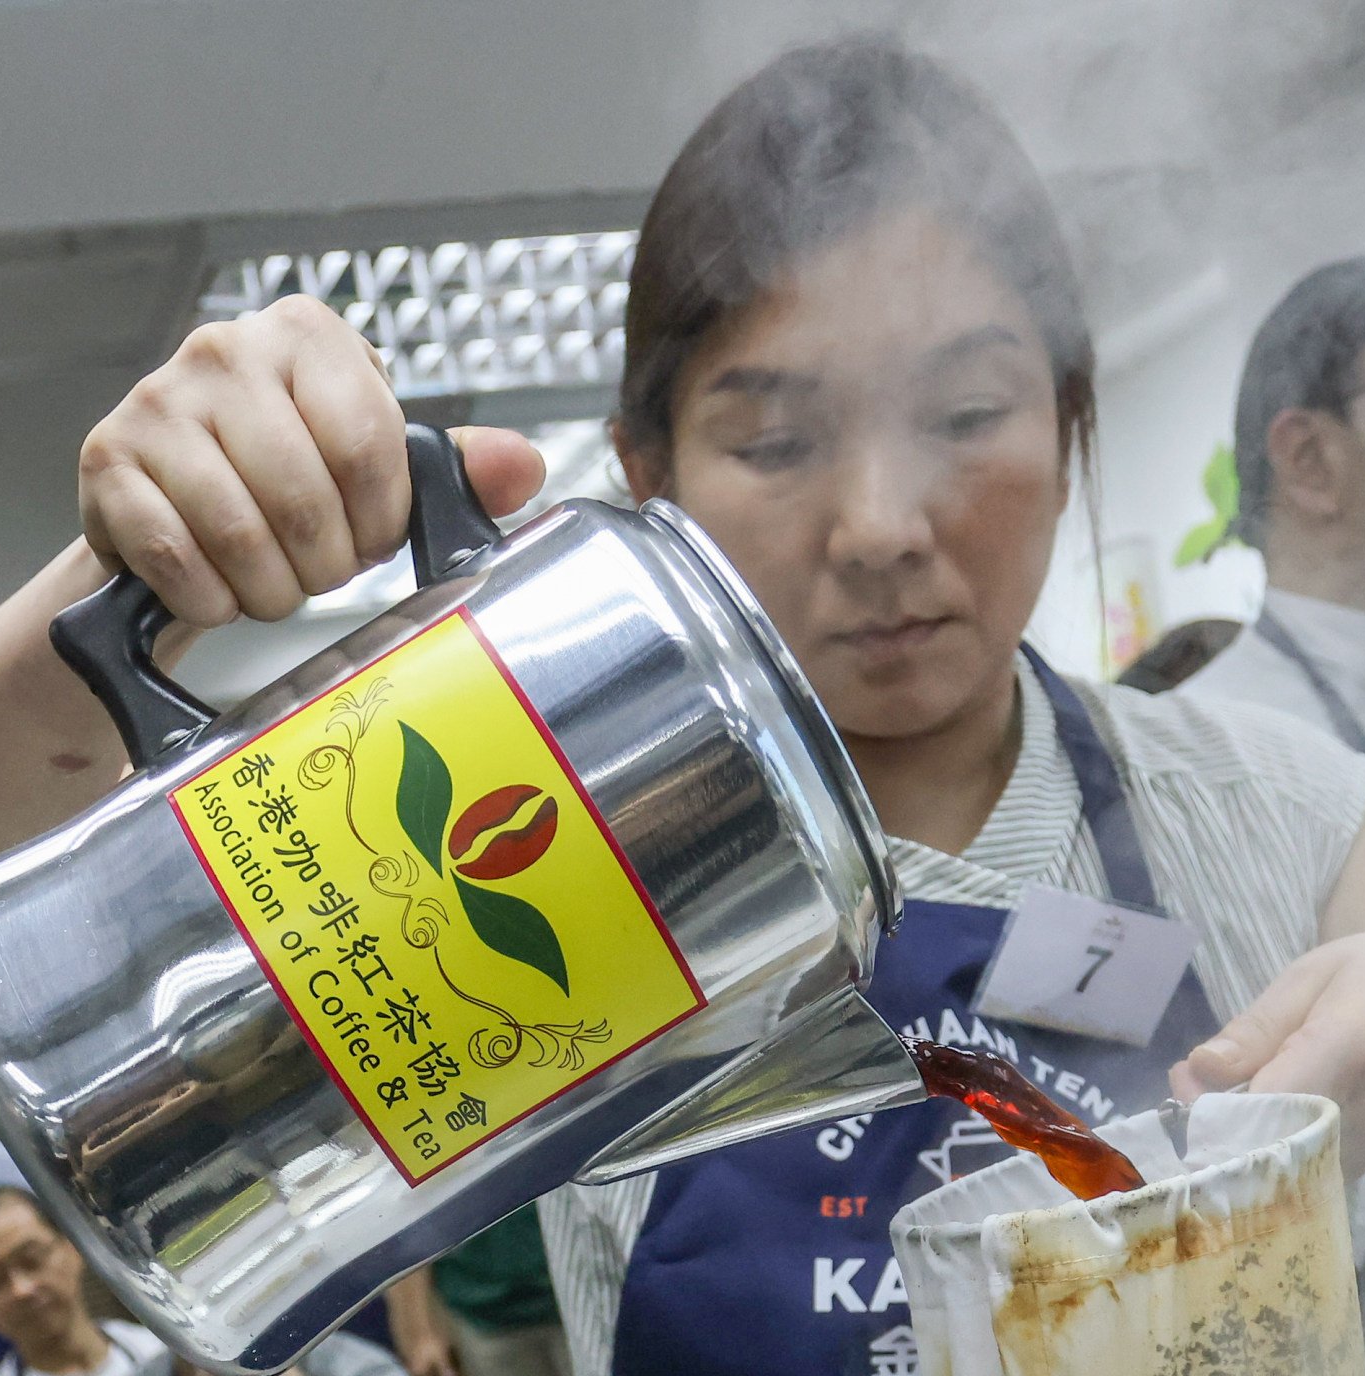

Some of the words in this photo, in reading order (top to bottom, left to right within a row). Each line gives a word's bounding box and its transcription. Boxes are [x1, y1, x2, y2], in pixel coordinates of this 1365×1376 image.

[193, 780, 286, 923] Association
[279, 930, 320, 964] of
[308, 970, 382, 1074] Coffee
[376, 1076, 409, 1110] &
[402, 1108, 443, 1161] Tea
[232, 752, 488, 1132] 香港咖啡紅茶協會
[1075, 945, 1114, 993] 7
[901, 1007, 1020, 1065] HAAN
[1029, 1055, 1130, 1124] TEN
[820, 1196, 868, 1218] EST
